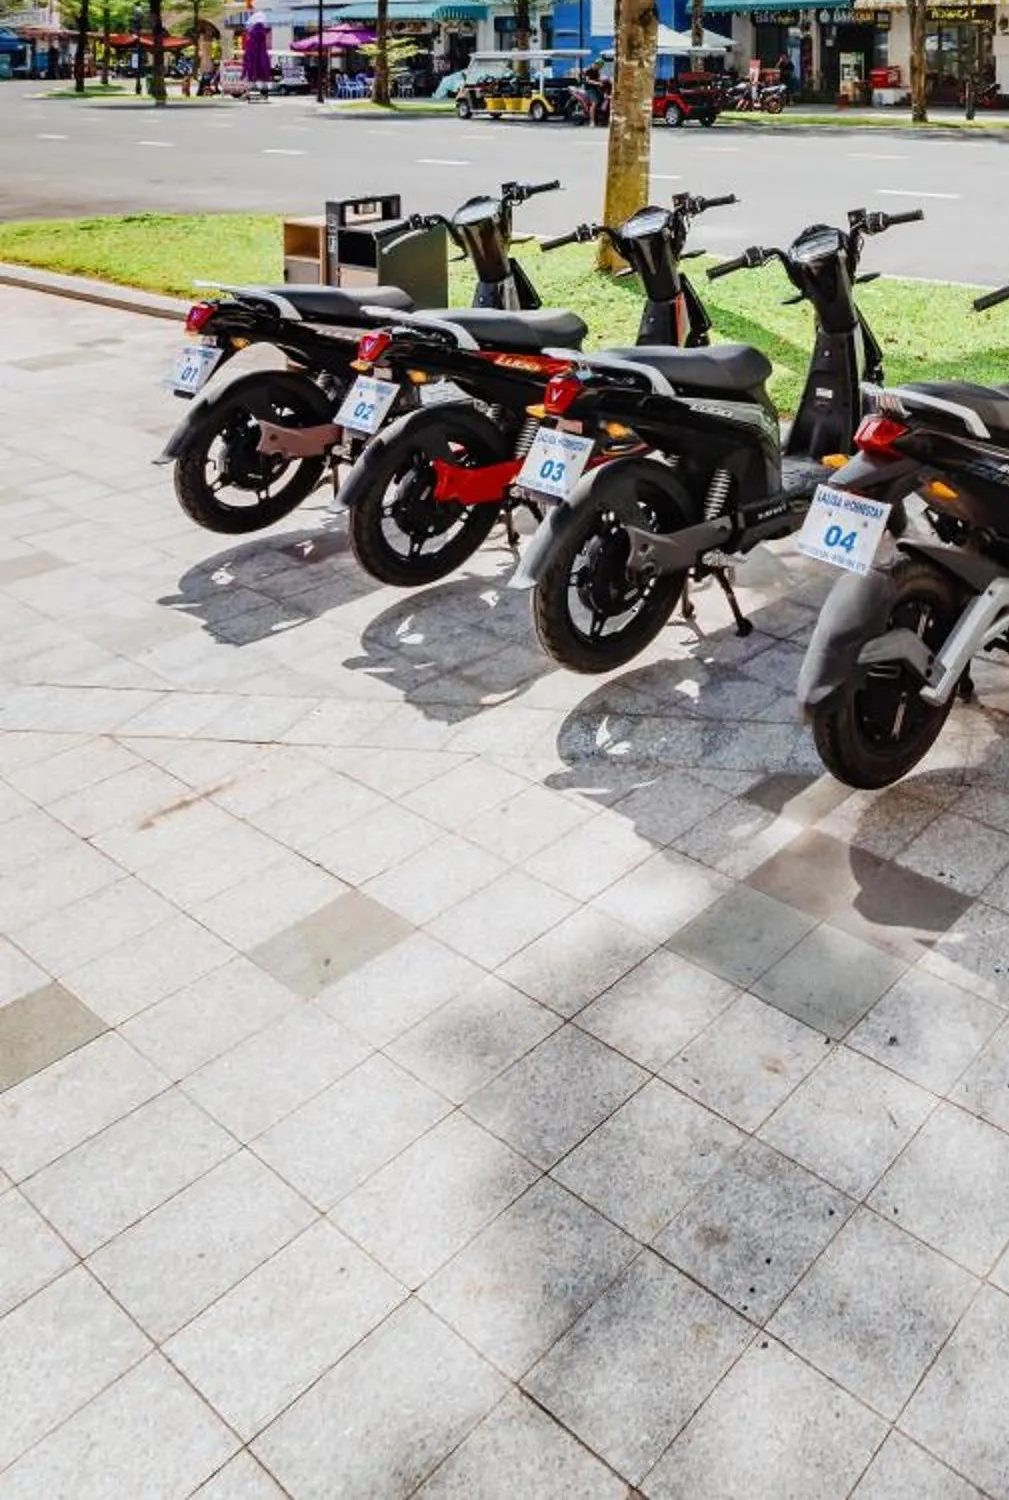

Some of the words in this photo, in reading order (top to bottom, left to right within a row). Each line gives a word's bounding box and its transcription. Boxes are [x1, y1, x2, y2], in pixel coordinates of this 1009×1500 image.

[181, 367, 199, 382] 01
[354, 402, 375, 420] 02
[540, 460, 566, 482] 03
[825, 526, 857, 553] 04
